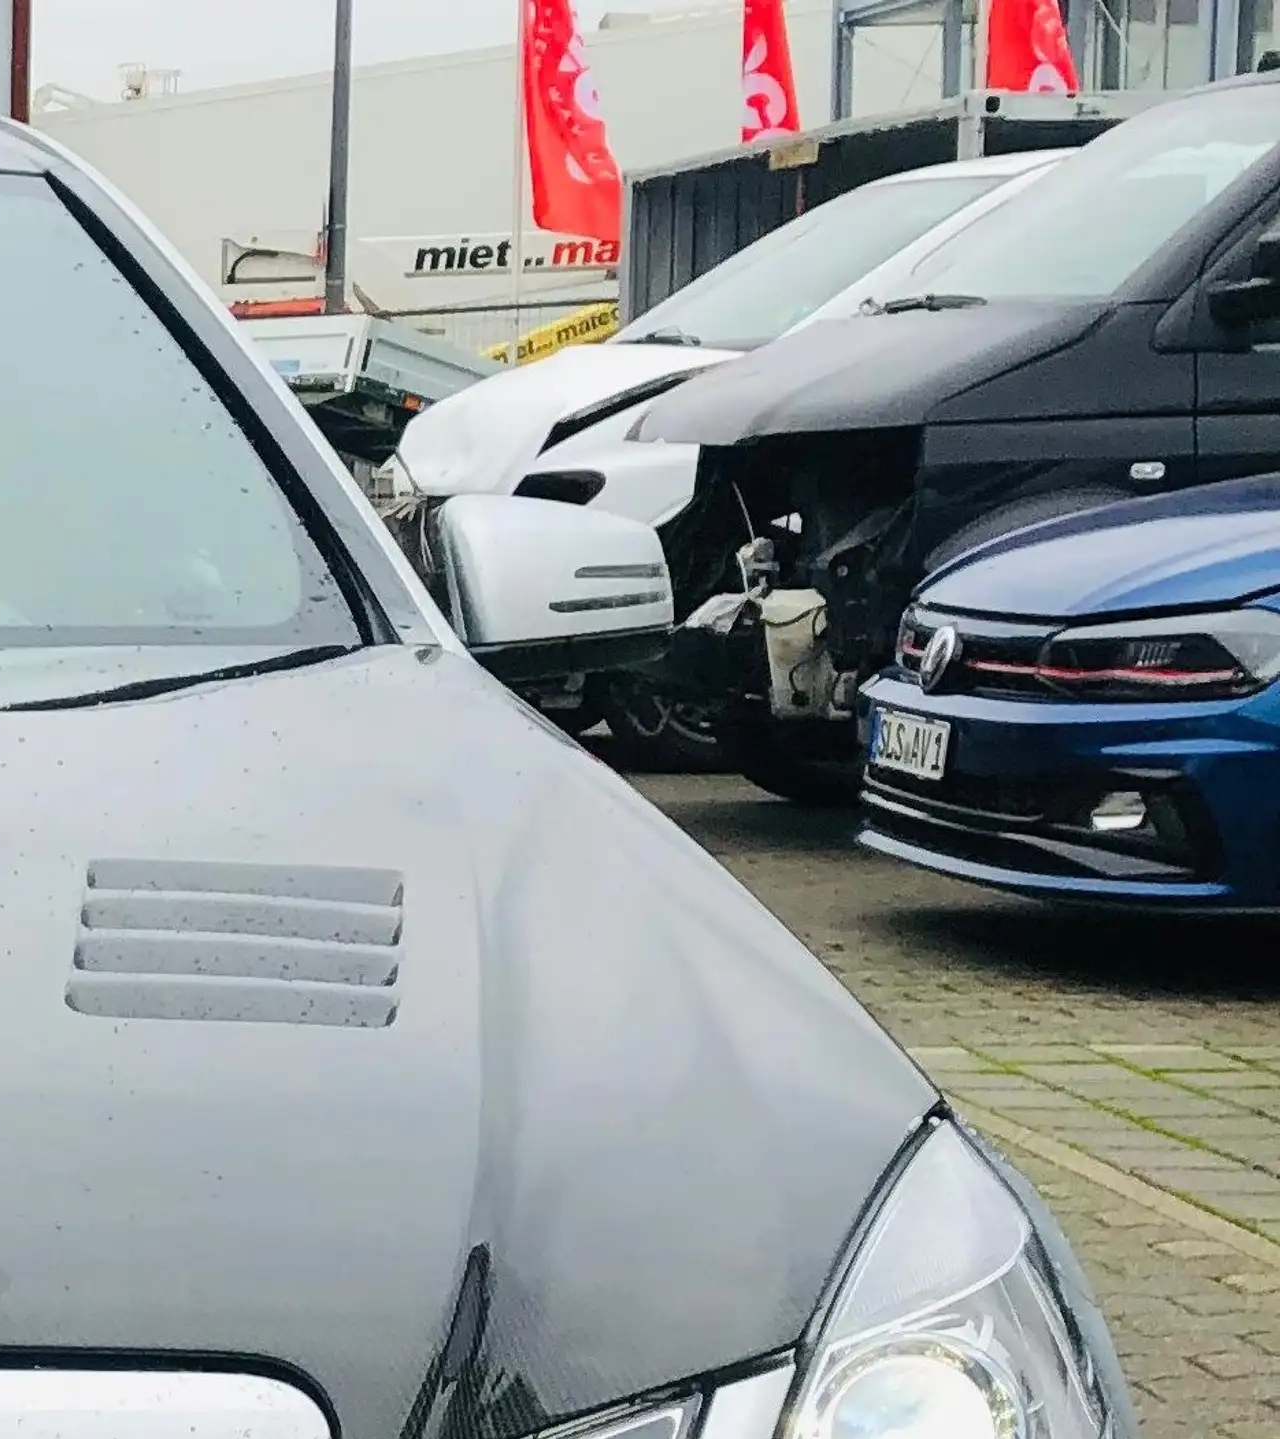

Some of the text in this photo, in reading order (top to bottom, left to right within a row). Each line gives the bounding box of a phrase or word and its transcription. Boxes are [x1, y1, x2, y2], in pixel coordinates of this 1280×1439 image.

[876, 719, 943, 771] SLS AV 1
